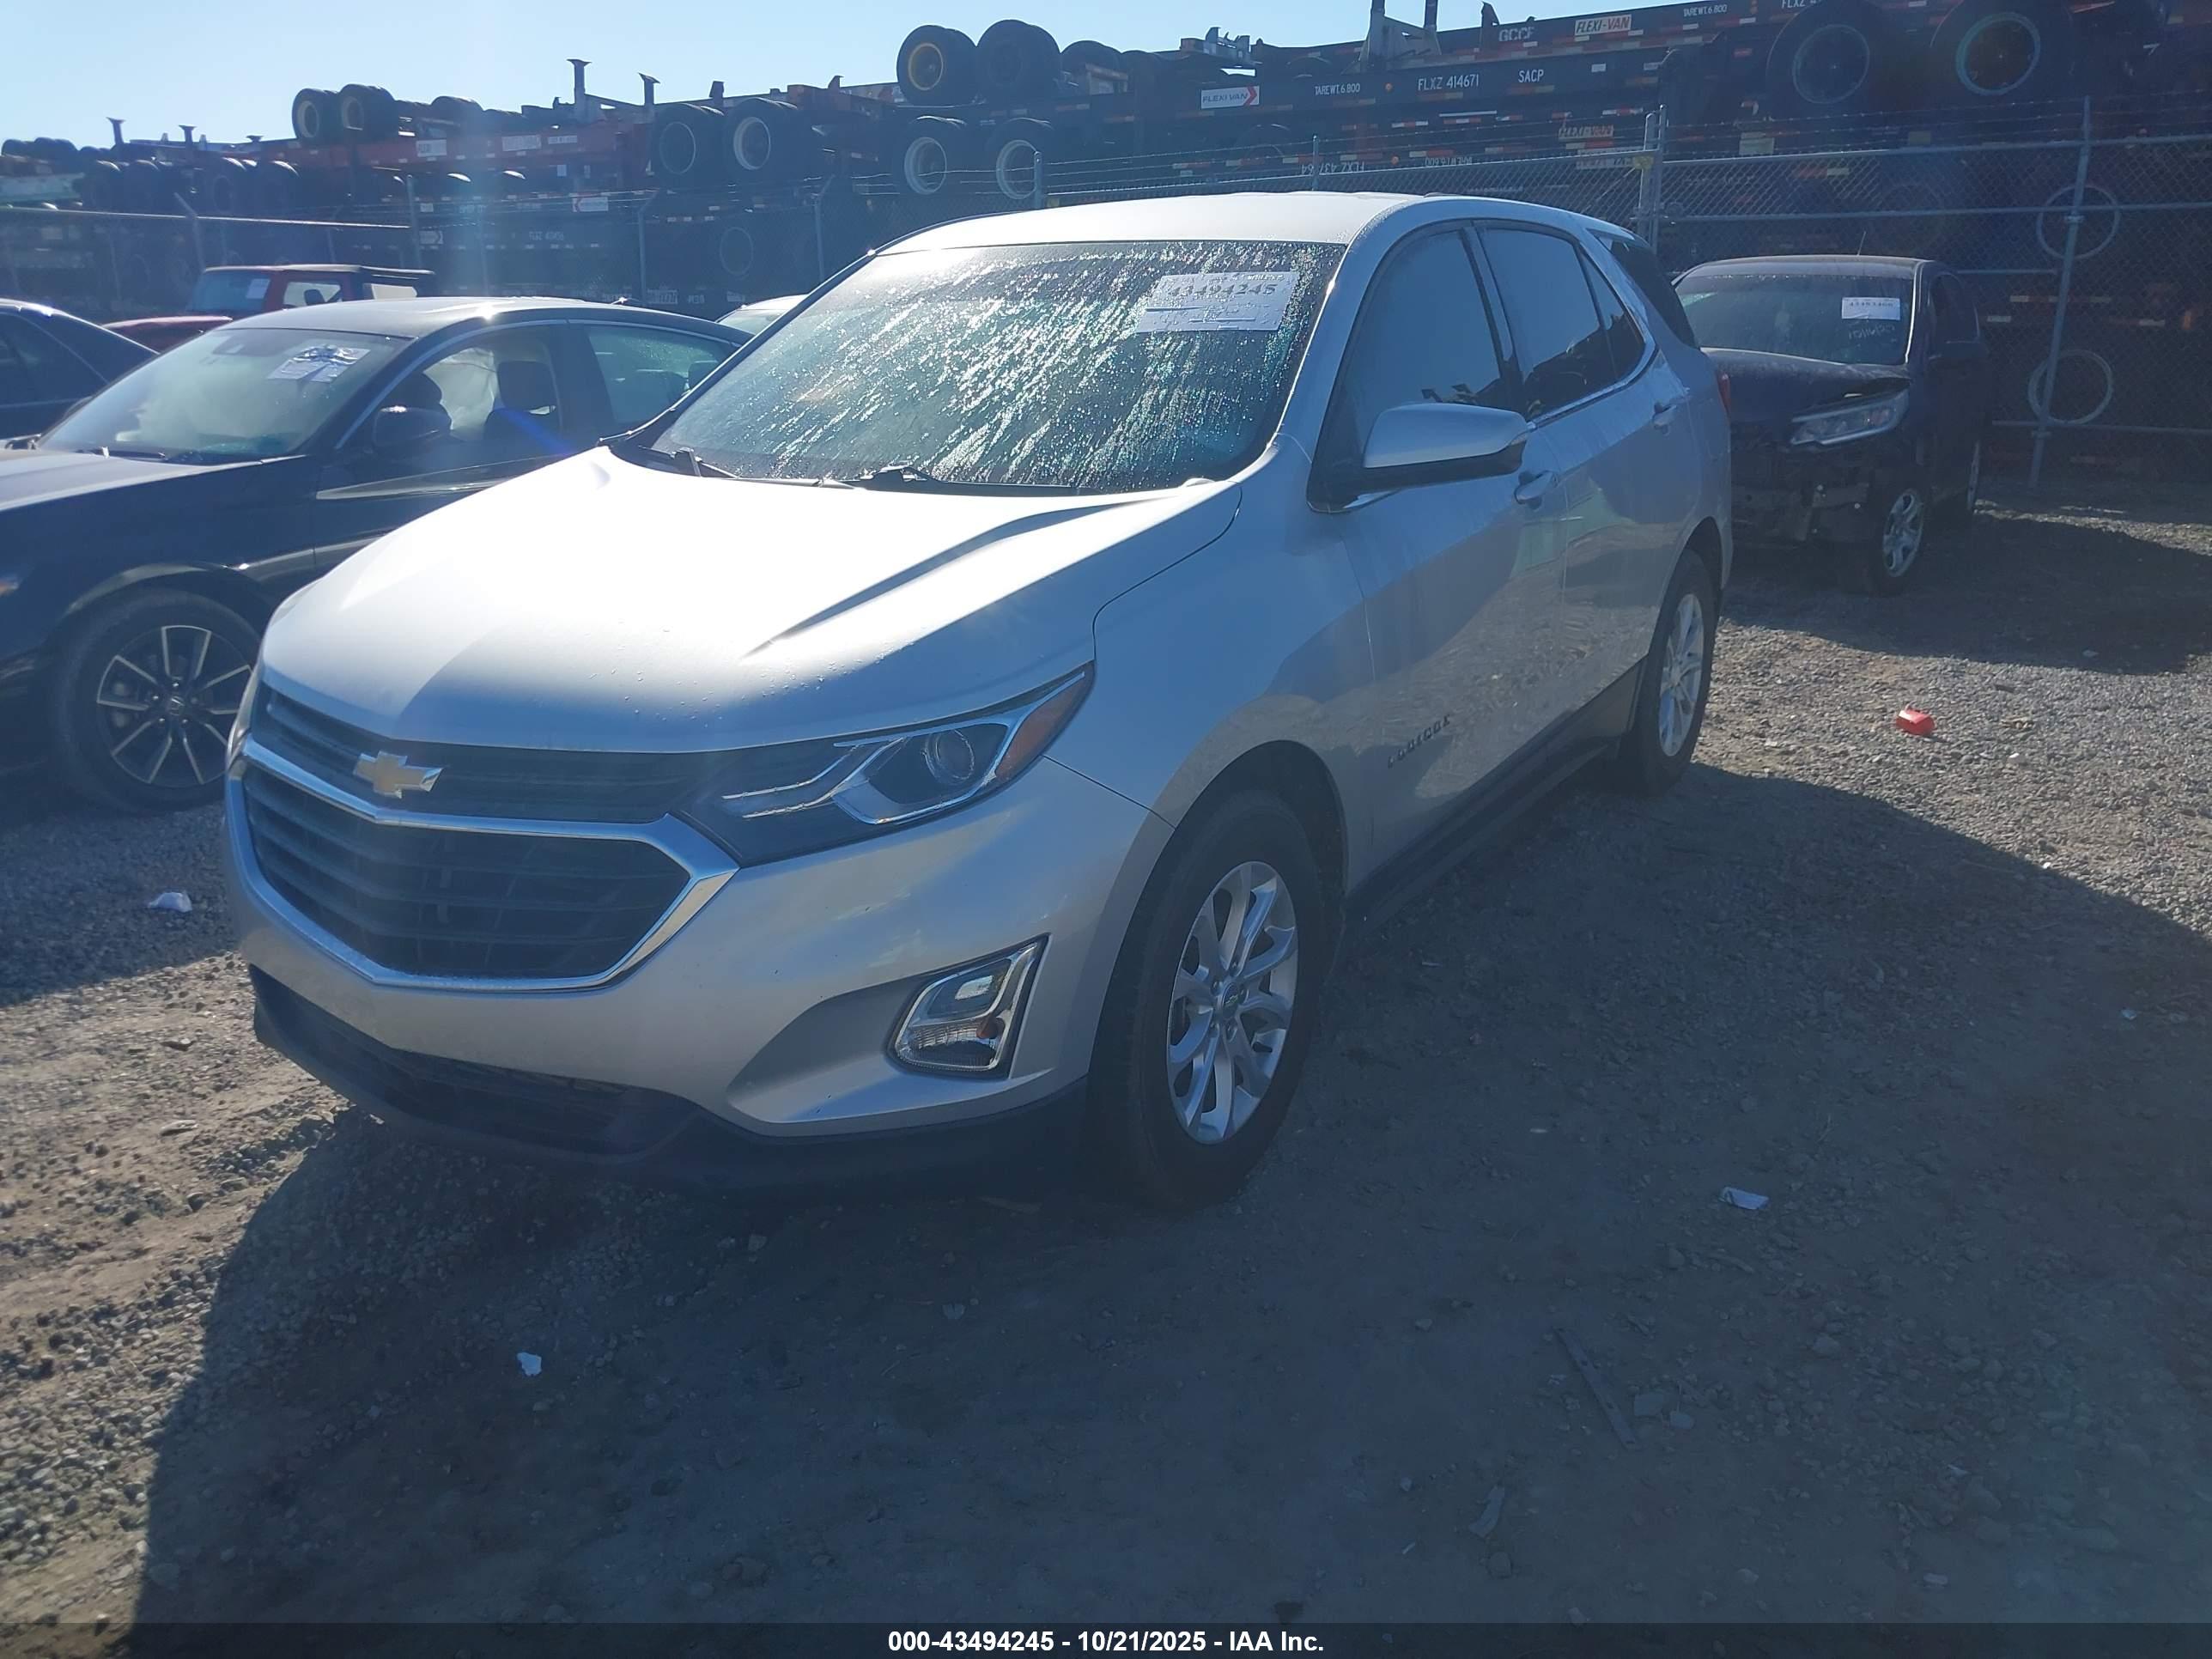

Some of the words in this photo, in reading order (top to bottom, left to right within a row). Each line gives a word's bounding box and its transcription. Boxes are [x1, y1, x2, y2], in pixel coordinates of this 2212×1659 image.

[1577, 17, 1630, 33] FLEXI-VAN
[1418, 76, 1443, 91] FLXZ
[1446, 74, 1479, 88] 414671
[1518, 70, 1545, 83] SACP
